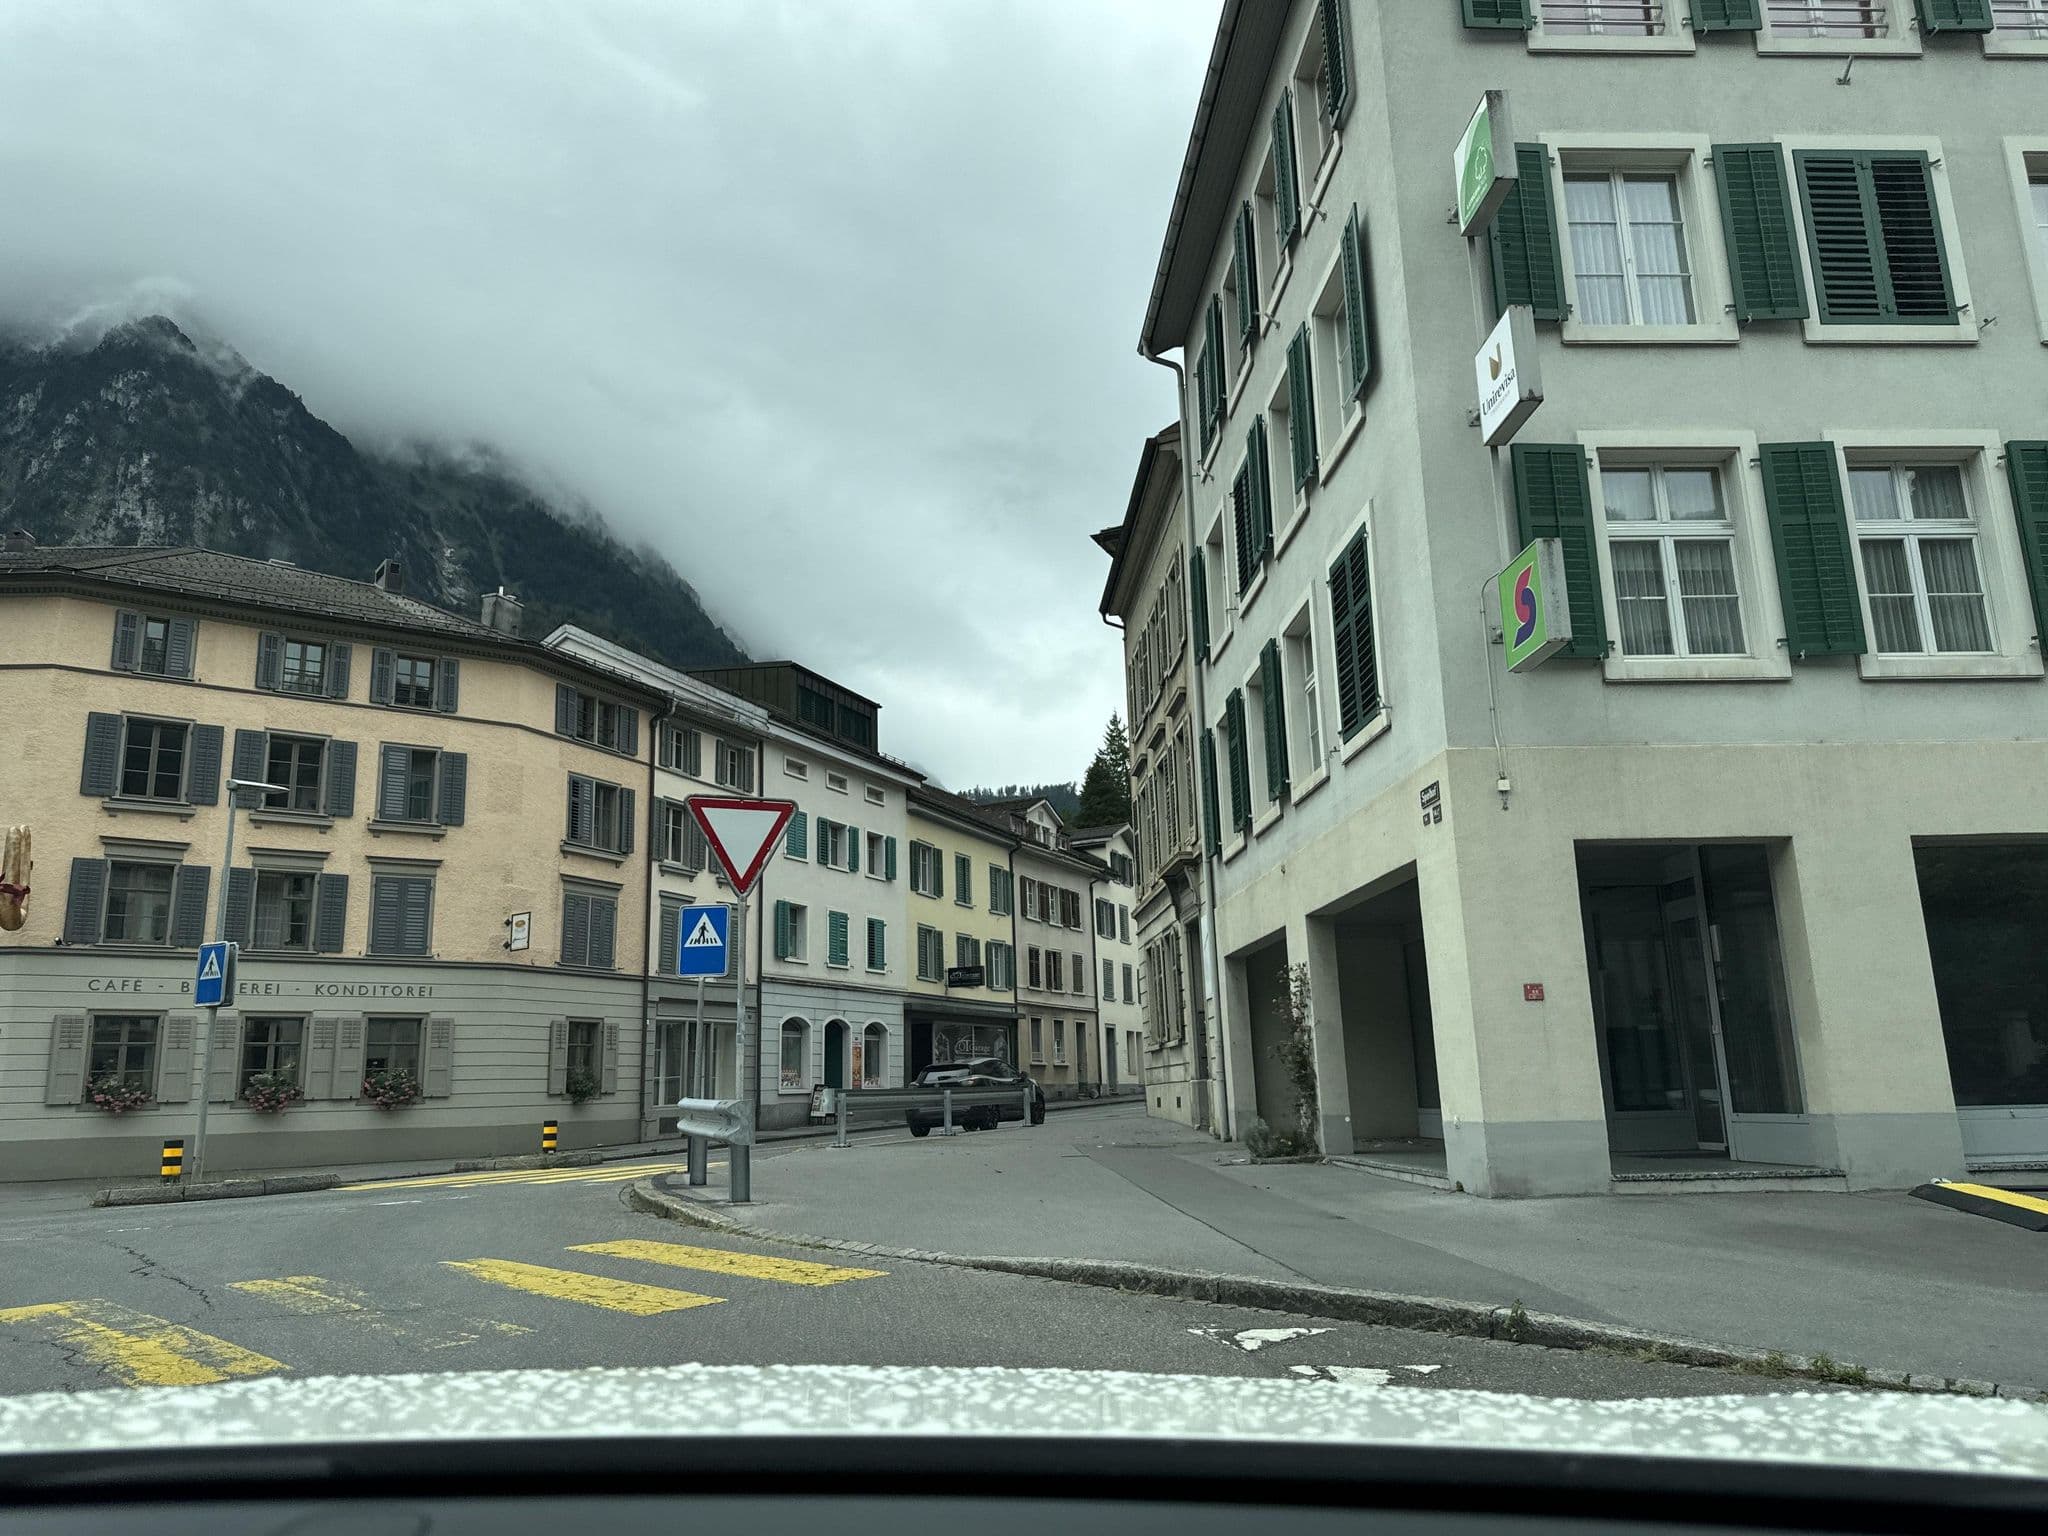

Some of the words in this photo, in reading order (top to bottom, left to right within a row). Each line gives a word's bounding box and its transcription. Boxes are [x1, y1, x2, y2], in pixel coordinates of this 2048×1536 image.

[1481, 368, 1516, 416] Unirevisa
[181, 981, 280, 995] BEREI
[315, 984, 433, 997] KONDITOREI
